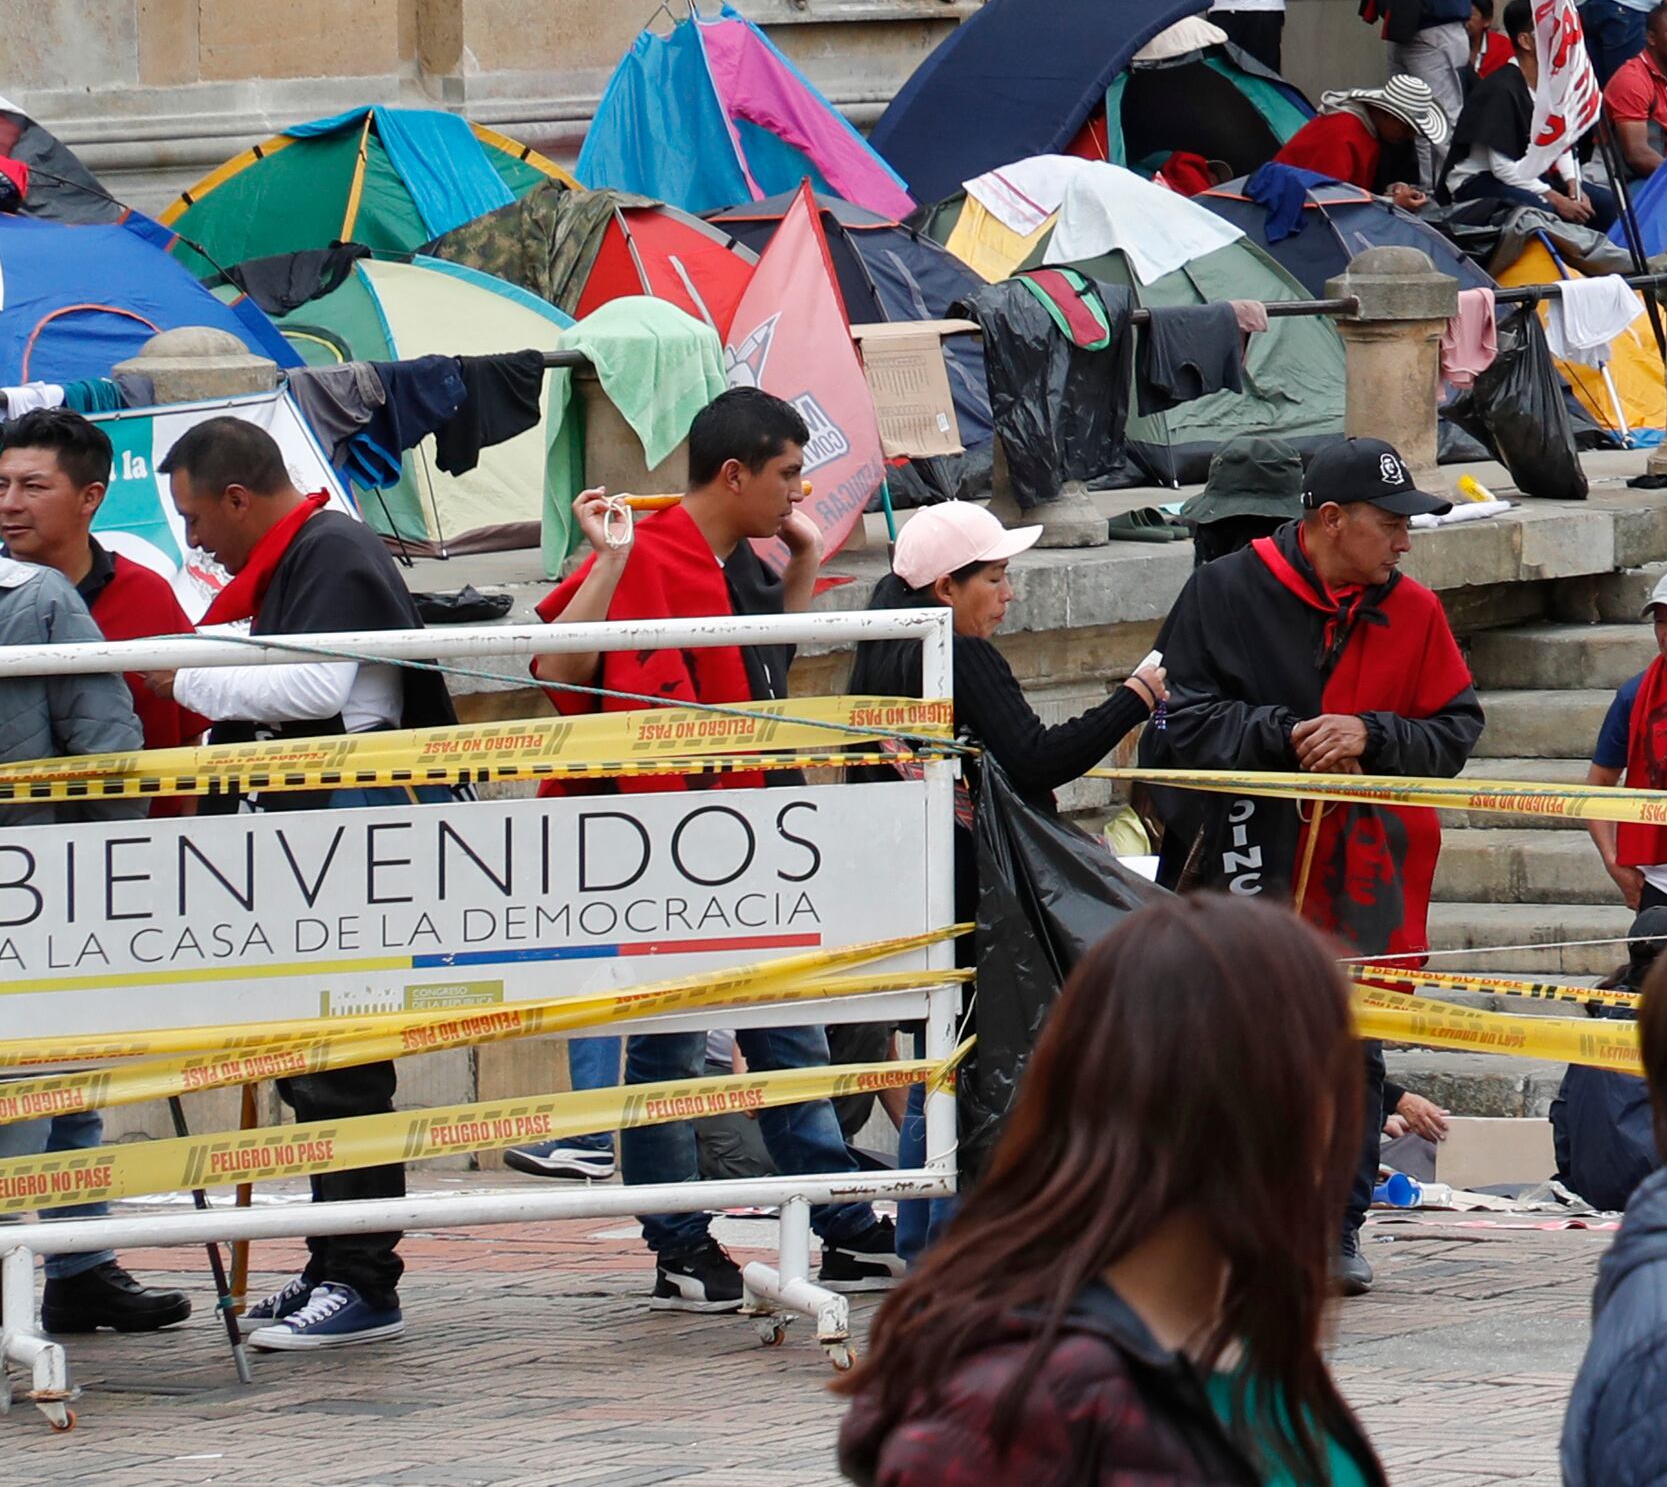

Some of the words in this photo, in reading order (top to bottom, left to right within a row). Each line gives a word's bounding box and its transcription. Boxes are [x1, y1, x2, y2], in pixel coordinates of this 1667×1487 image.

[122, 449, 148, 480] la
[0, 801, 822, 927] BIENVENIDOS
[0, 937, 27, 971] A
[48, 932, 111, 970] LA
[129, 921, 275, 963] CASA
[295, 915, 360, 953] DE
[381, 911, 442, 947] LA
[462, 890, 821, 943] DEMOCRACIA
[430, 1121, 489, 1147] PELIGRO
[491, 1119, 513, 1139] NO
[515, 1113, 552, 1137] PASE
[210, 1148, 271, 1174] PELIGRO
[274, 1145, 295, 1166] NO
[297, 1139, 335, 1163] PASE
